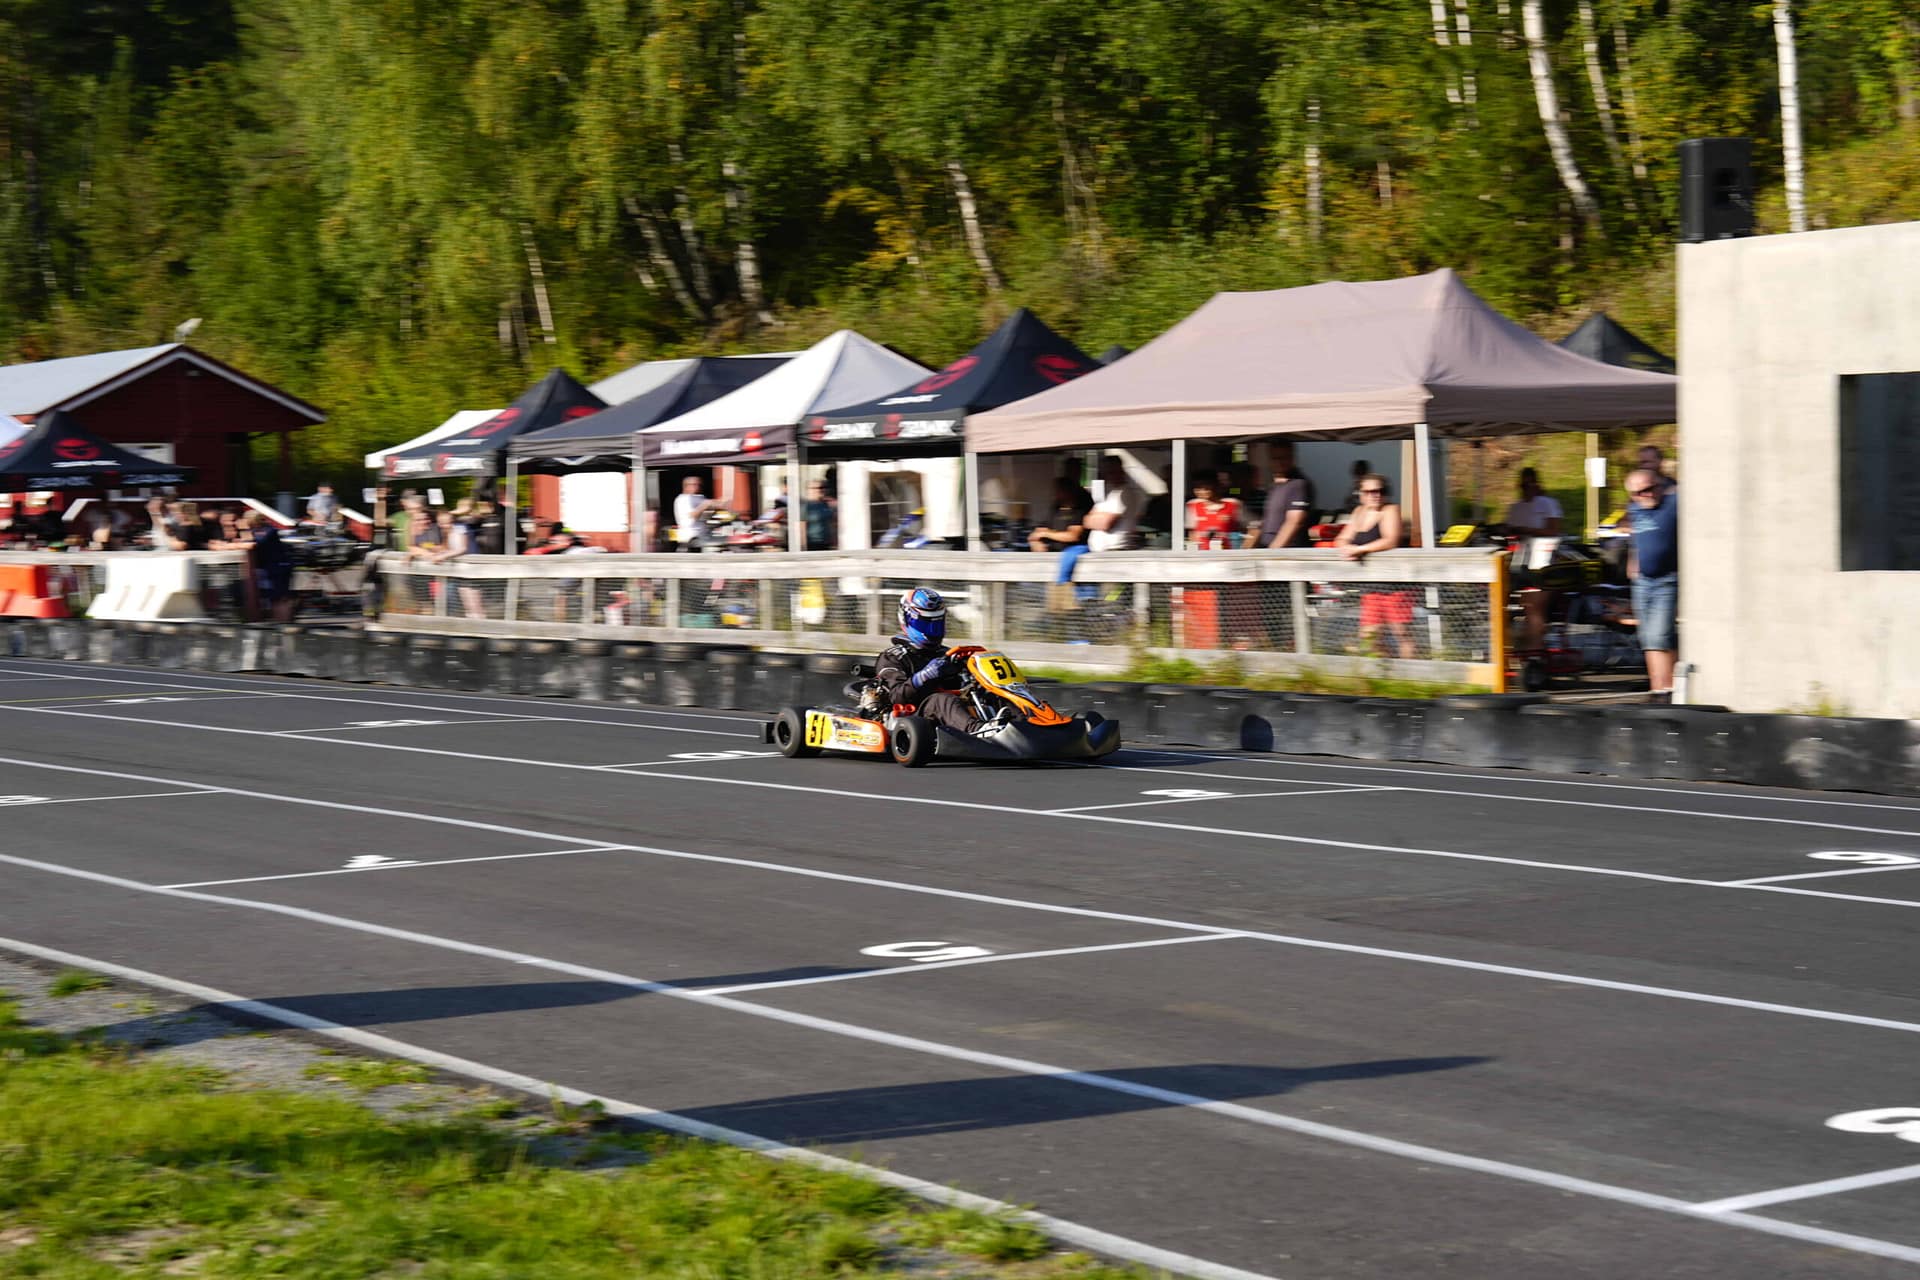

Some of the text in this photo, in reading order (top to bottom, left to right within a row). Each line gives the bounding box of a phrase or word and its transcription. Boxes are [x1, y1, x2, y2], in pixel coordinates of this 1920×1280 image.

[990, 658, 1016, 680] 51
[810, 714, 825, 745] 51
[860, 941, 995, 962] 5
